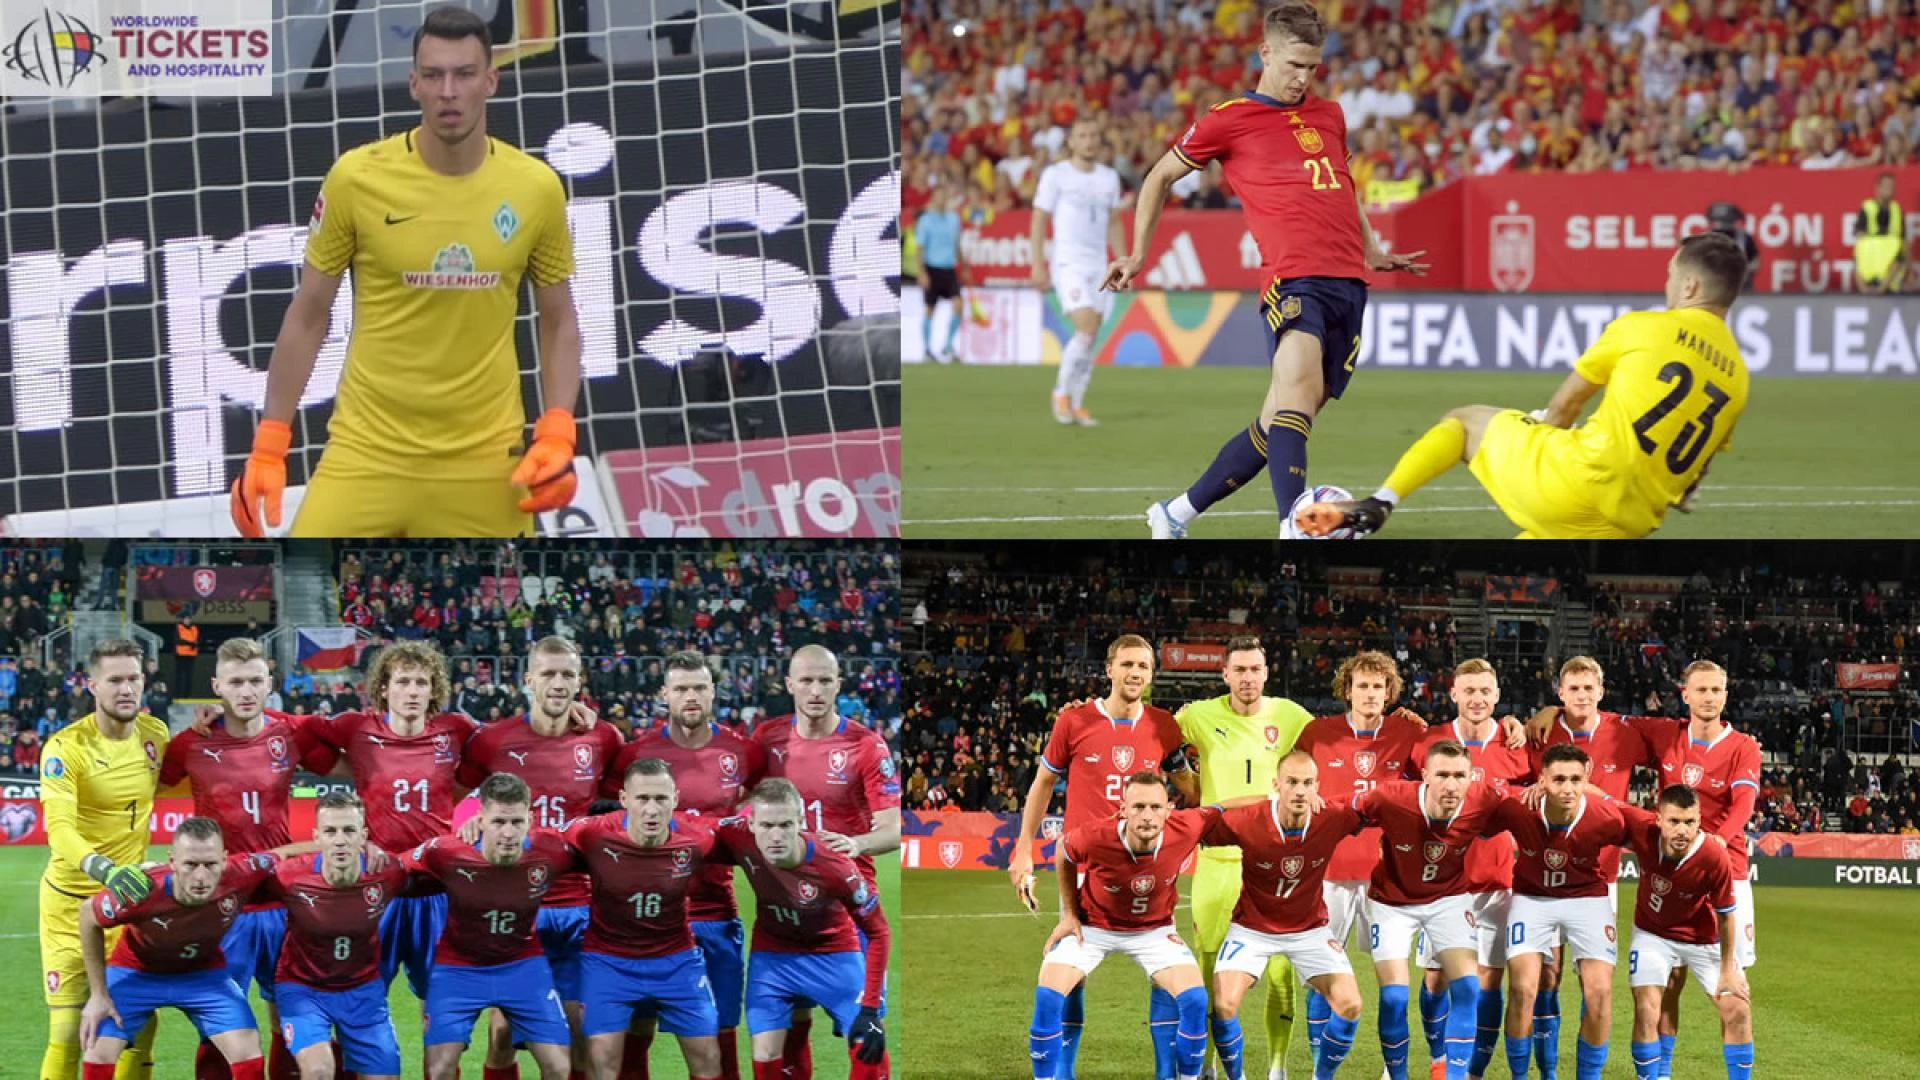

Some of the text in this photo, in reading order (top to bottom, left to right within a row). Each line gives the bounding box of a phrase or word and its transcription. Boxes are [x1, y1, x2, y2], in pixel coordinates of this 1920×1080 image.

[1303, 157, 1341, 190] 21
[1565, 204, 1822, 249] SELECÓN
[404, 274, 499, 287] WIESENHOF
[1496, 304, 1772, 373] NATS
[1795, 306, 1920, 374] LEA
[1632, 361, 1731, 475] 23
[1245, 759, 1251, 785] 1
[394, 778, 429, 813] 21
[1106, 775, 1130, 800] 2
[124, 800, 137, 831] 1
[242, 791, 261, 825] 4
[533, 795, 566, 829] 15
[1422, 864, 1439, 881] 8
[1543, 871, 1567, 887] 10
[1836, 865, 1912, 884] FOTBAL
[1275, 878, 1299, 899] 17
[1131, 897, 1149, 914] 5
[1648, 894, 1663, 913] 9
[482, 910, 516, 934] 12
[180, 943, 200, 959] 5
[333, 936, 351, 960] 8
[1219, 940, 1246, 961] 17
